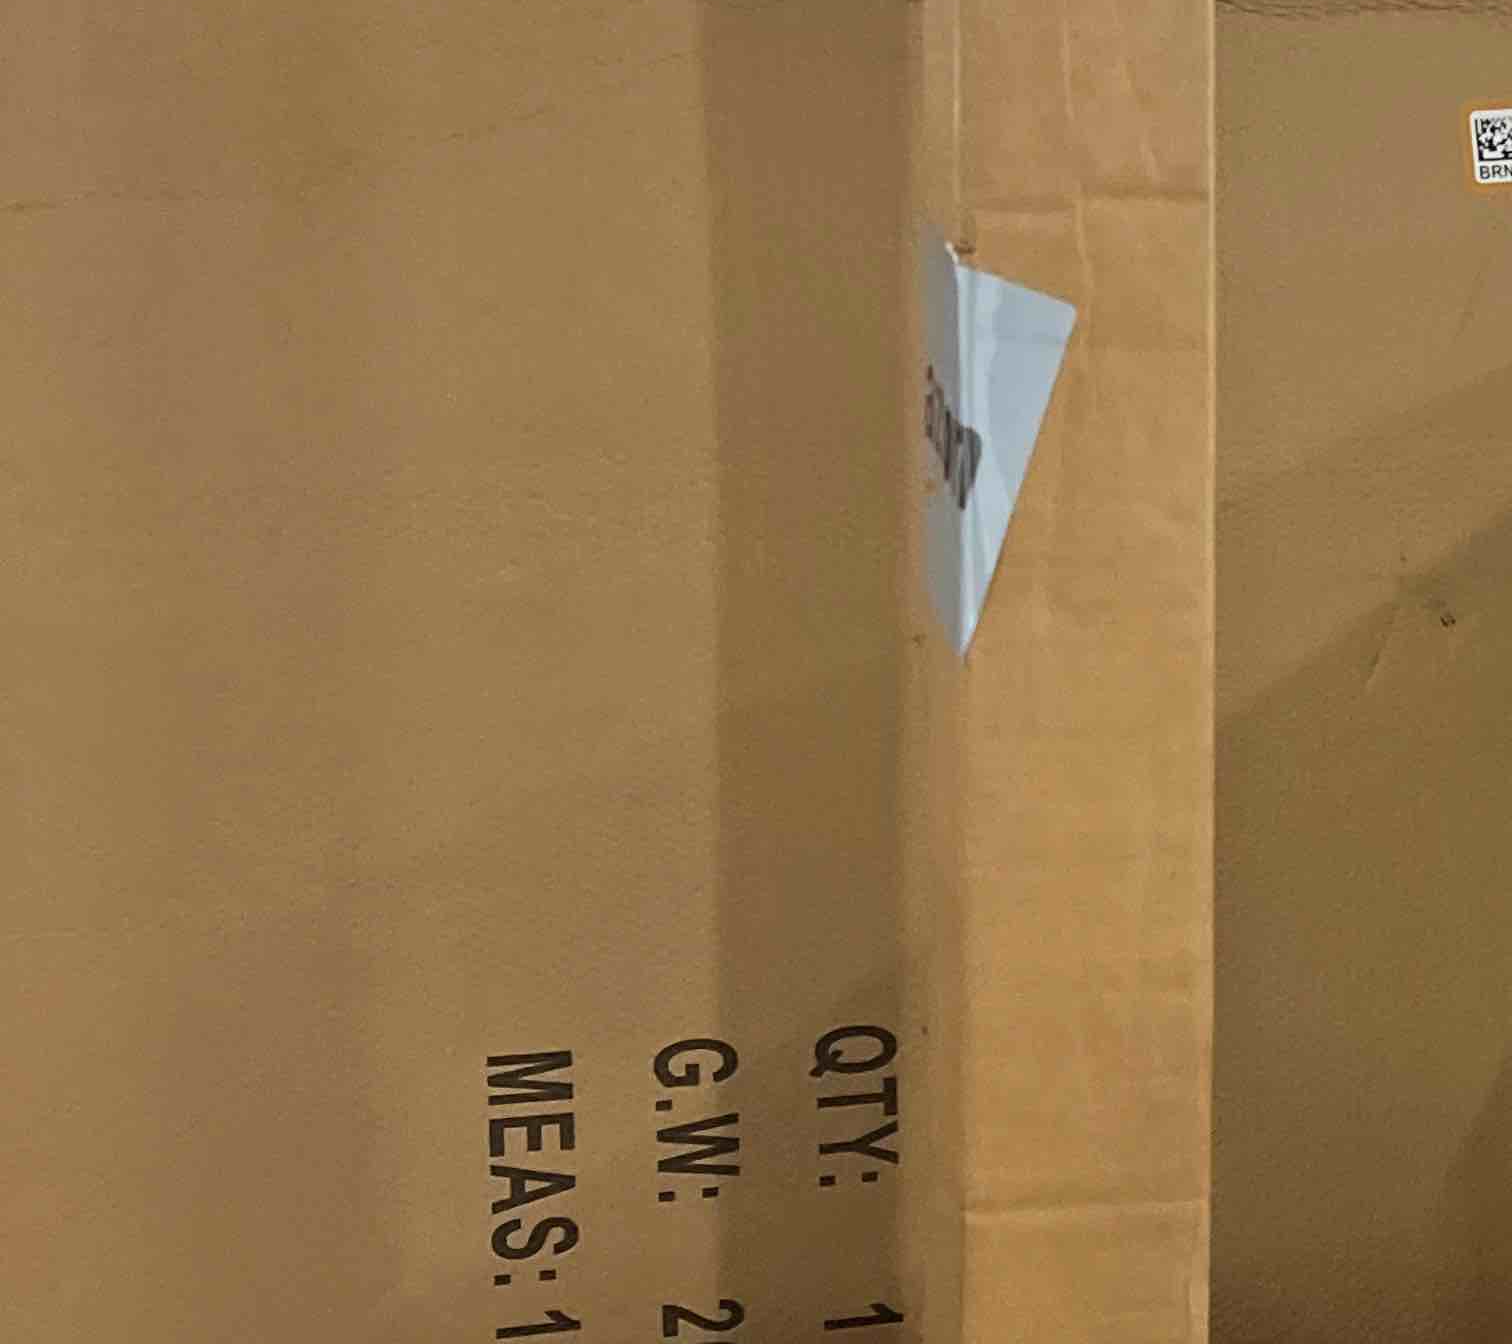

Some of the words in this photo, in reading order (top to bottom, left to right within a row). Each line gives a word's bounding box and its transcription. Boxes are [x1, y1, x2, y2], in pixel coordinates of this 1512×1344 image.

[653, 1038, 742, 1203] G.W:
[808, 1024, 900, 1187] QTY:
[823, 1301, 905, 1332] 1
